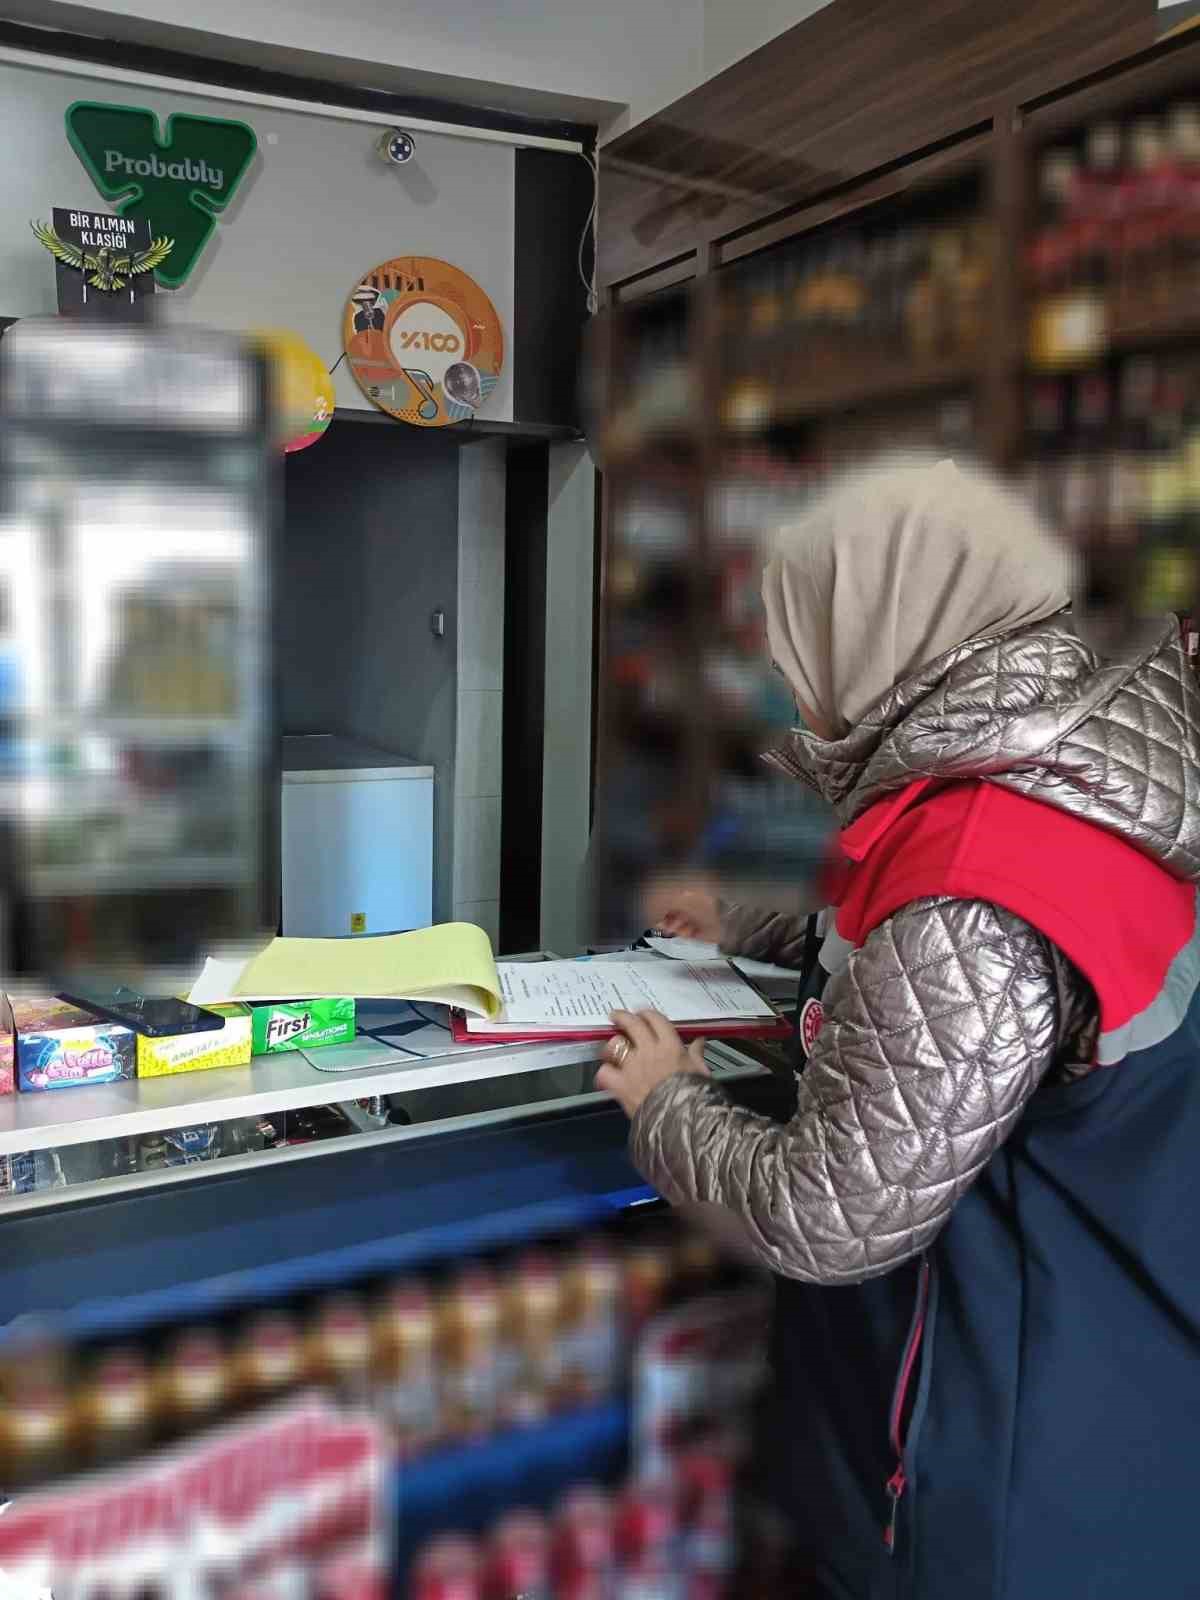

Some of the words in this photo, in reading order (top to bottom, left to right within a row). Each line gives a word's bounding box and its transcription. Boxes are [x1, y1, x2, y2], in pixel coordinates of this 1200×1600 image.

[104, 149, 225, 190] Probably
[69, 211, 91, 229] BİR
[93, 215, 136, 234] ALMAN
[80, 229, 127, 250] KLASİĞİ
[400, 330, 460, 353] %100
[266, 1012, 311, 1040] First
